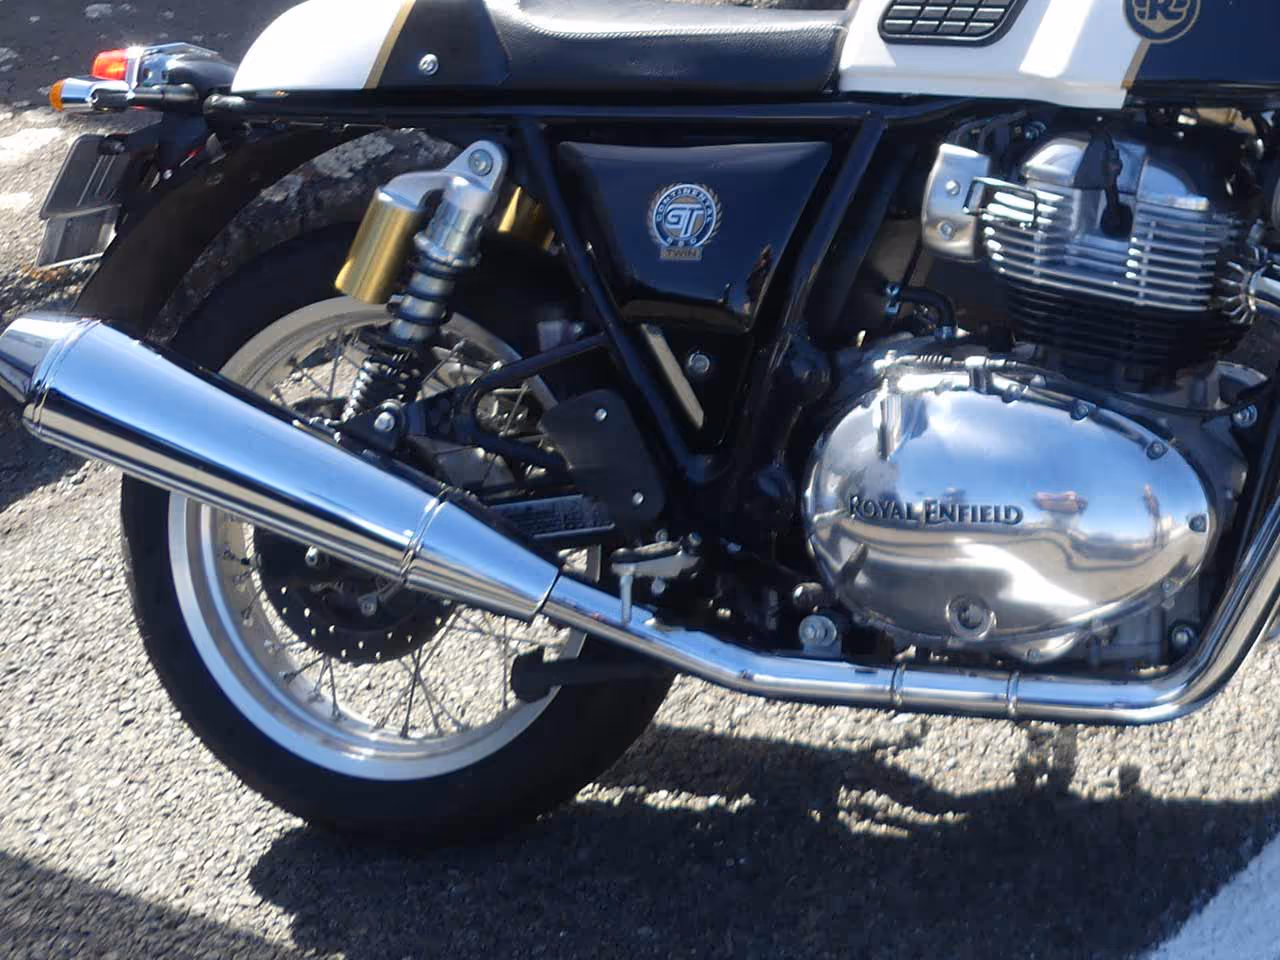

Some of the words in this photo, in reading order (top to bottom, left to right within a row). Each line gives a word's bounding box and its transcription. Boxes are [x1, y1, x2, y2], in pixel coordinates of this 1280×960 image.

[665, 203, 705, 238] GT
[849, 495, 920, 521] ROYAL
[923, 499, 1024, 526] ENFIELD
